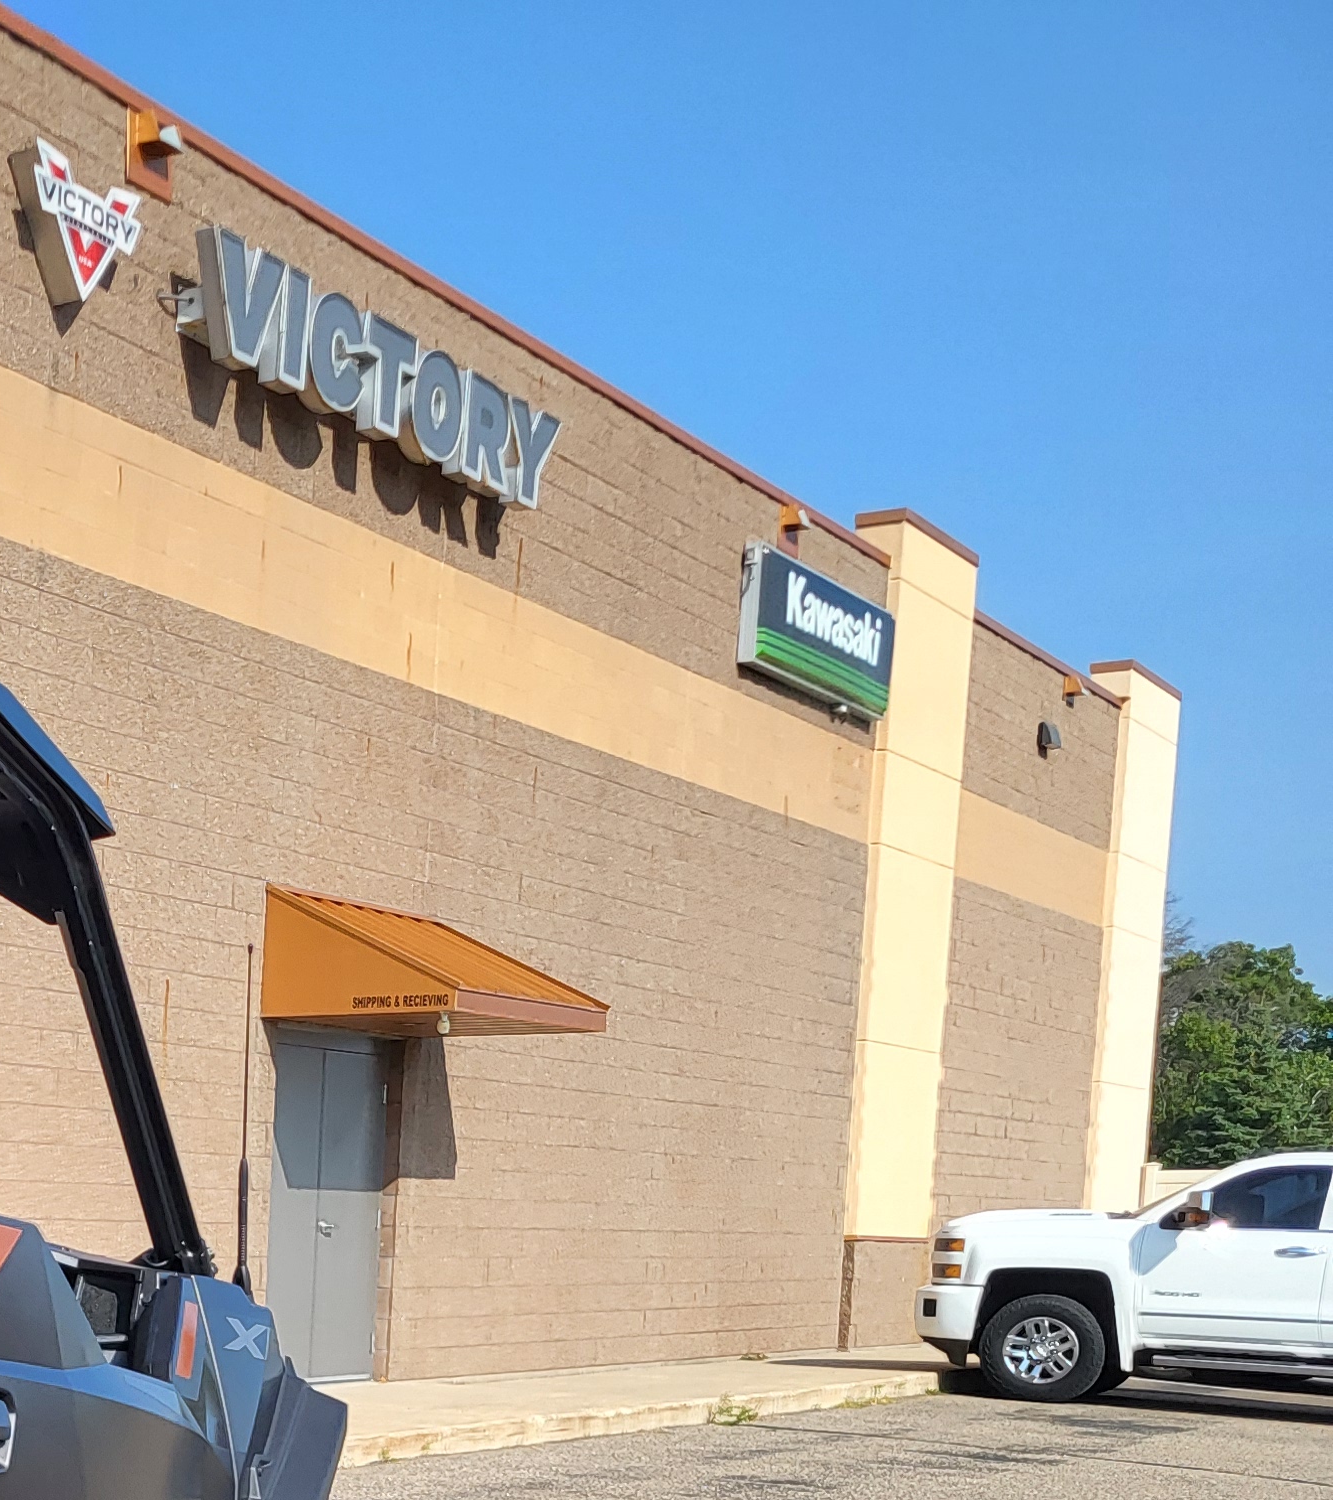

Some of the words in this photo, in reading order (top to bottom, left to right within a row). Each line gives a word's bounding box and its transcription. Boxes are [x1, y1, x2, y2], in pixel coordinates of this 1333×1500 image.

[42, 177, 134, 244] VICTORY
[212, 223, 562, 511] VICTORY
[785, 570, 883, 667] Kawasaki
[351, 995, 392, 1009] SHIPPING
[393, 995, 400, 1007] &
[402, 993, 449, 1008] RECIEVING
